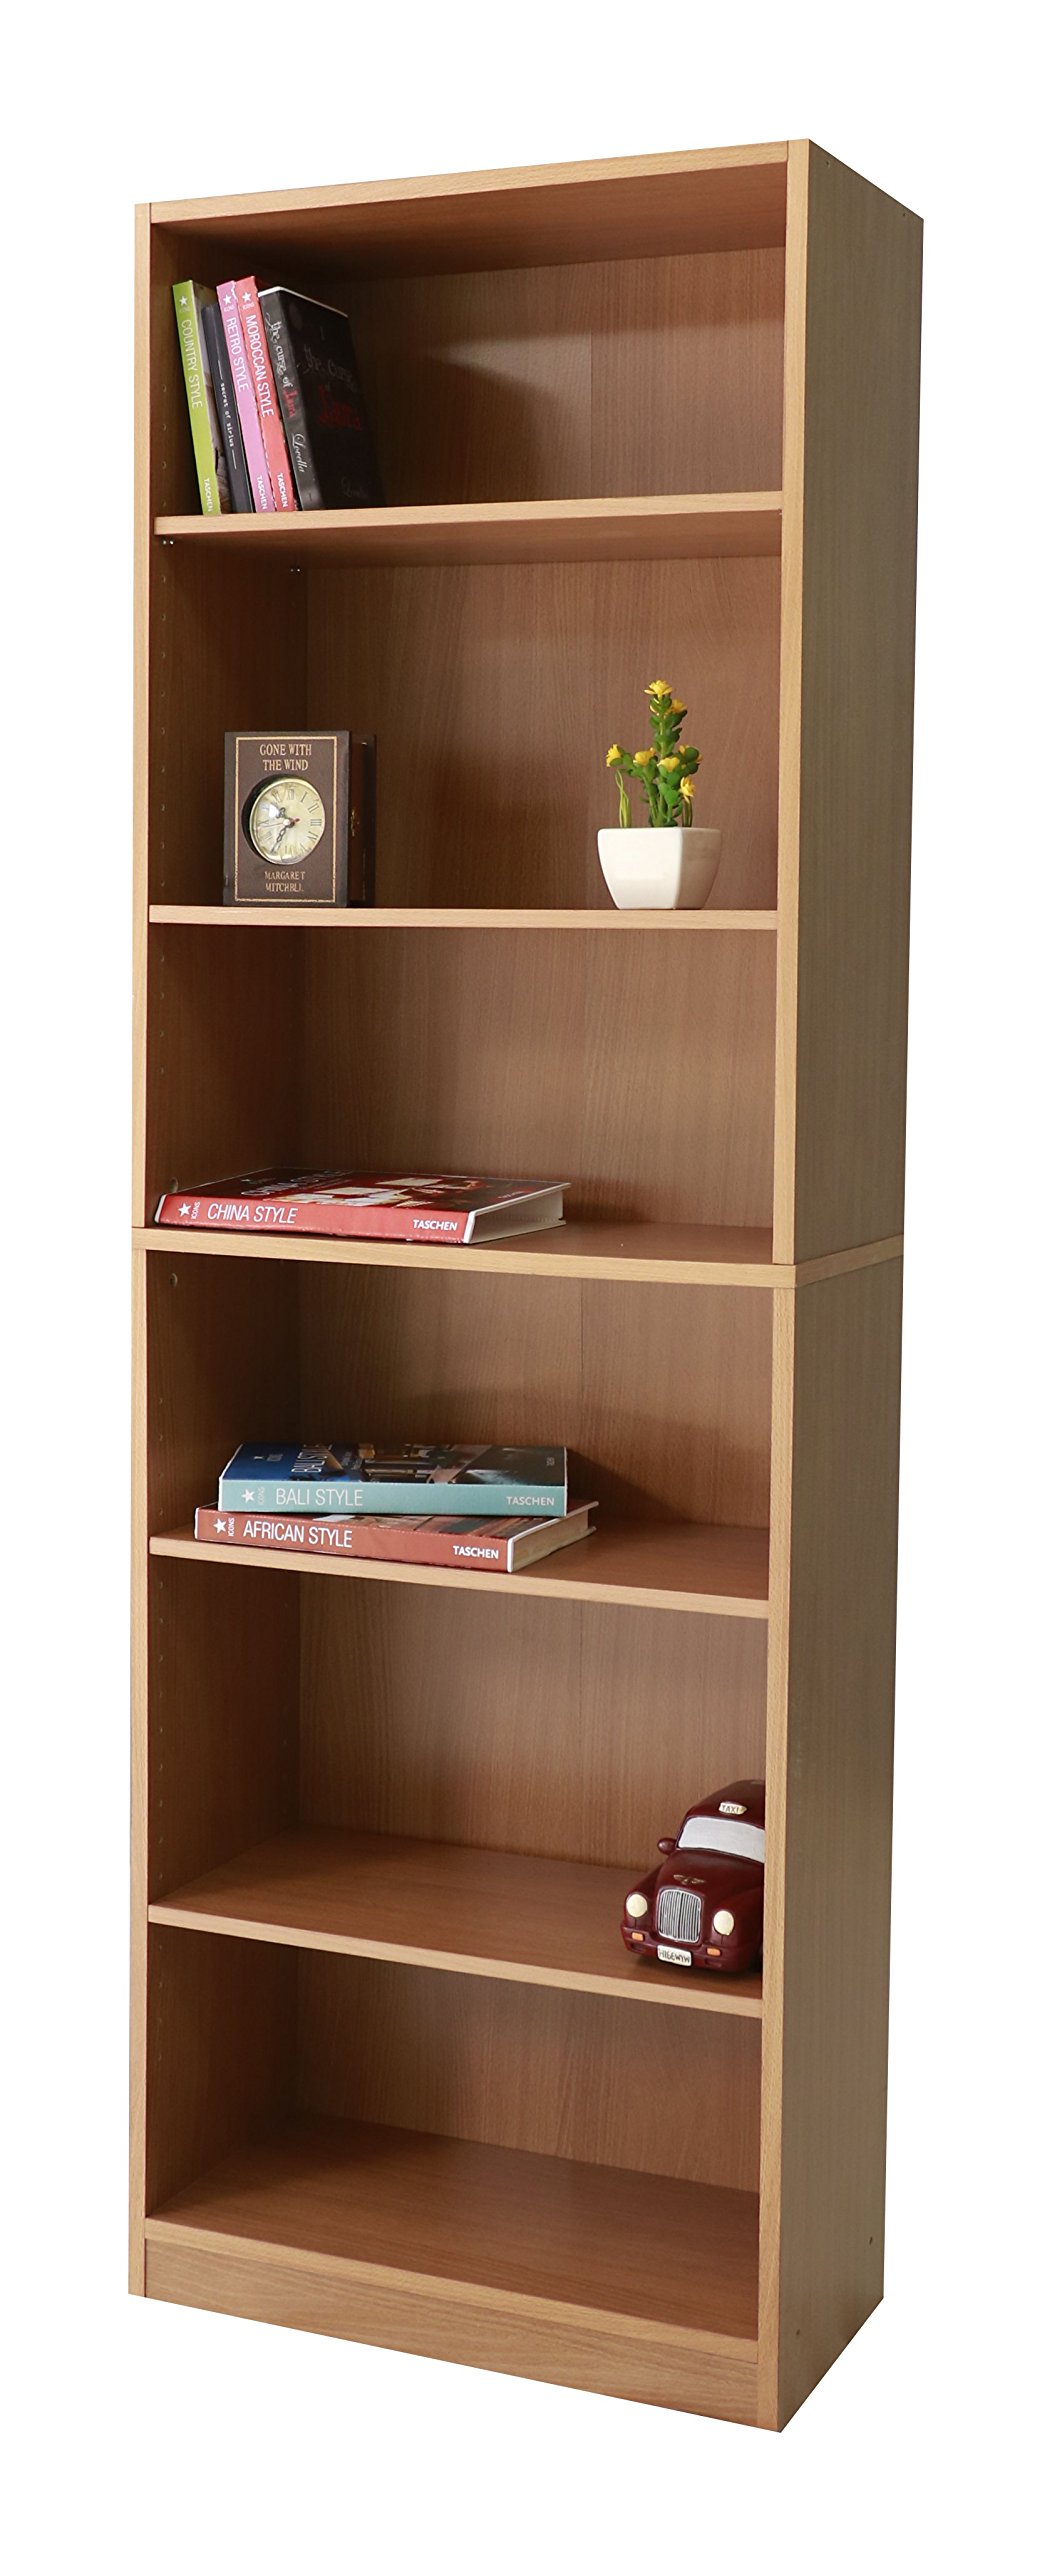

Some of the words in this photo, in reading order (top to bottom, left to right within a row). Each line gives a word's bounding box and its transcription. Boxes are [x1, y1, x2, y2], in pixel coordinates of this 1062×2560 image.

[181, 319, 198, 373] COUNTRY
[226, 317, 241, 355] RETRO
[233, 357, 249, 392] STYLE
[245, 314, 266, 381] MOROCCAN
[257, 382, 274, 417] STYLE
[188, 374, 202, 408] STYLE
[204, 478, 213, 512] TASCHEN
[256, 475, 267, 510] TASCHEN
[276, 472, 288, 507] TASCHEN
[259, 744, 286, 756] GONE
[288, 743, 312, 756] WITH
[263, 759, 281, 771] THE
[284, 759, 309, 771] WIND
[264, 871, 305, 880] MARGARET
[207, 1203, 249, 1221] CHINA
[253, 1206, 299, 1224] STYLE
[413, 1219, 458, 1231] TASCHEN
[276, 1488, 310, 1505] BALI
[315, 1488, 363, 1506] STYLE
[506, 1496, 555, 1506] TASCHEN
[227, 1517, 235, 1537] ICONS
[243, 1520, 304, 1543] AFRICAN
[308, 1526, 353, 1548] STYLE
[453, 1545, 499, 1559] TASCHEN
[722, 1805, 739, 1814] TAXI
